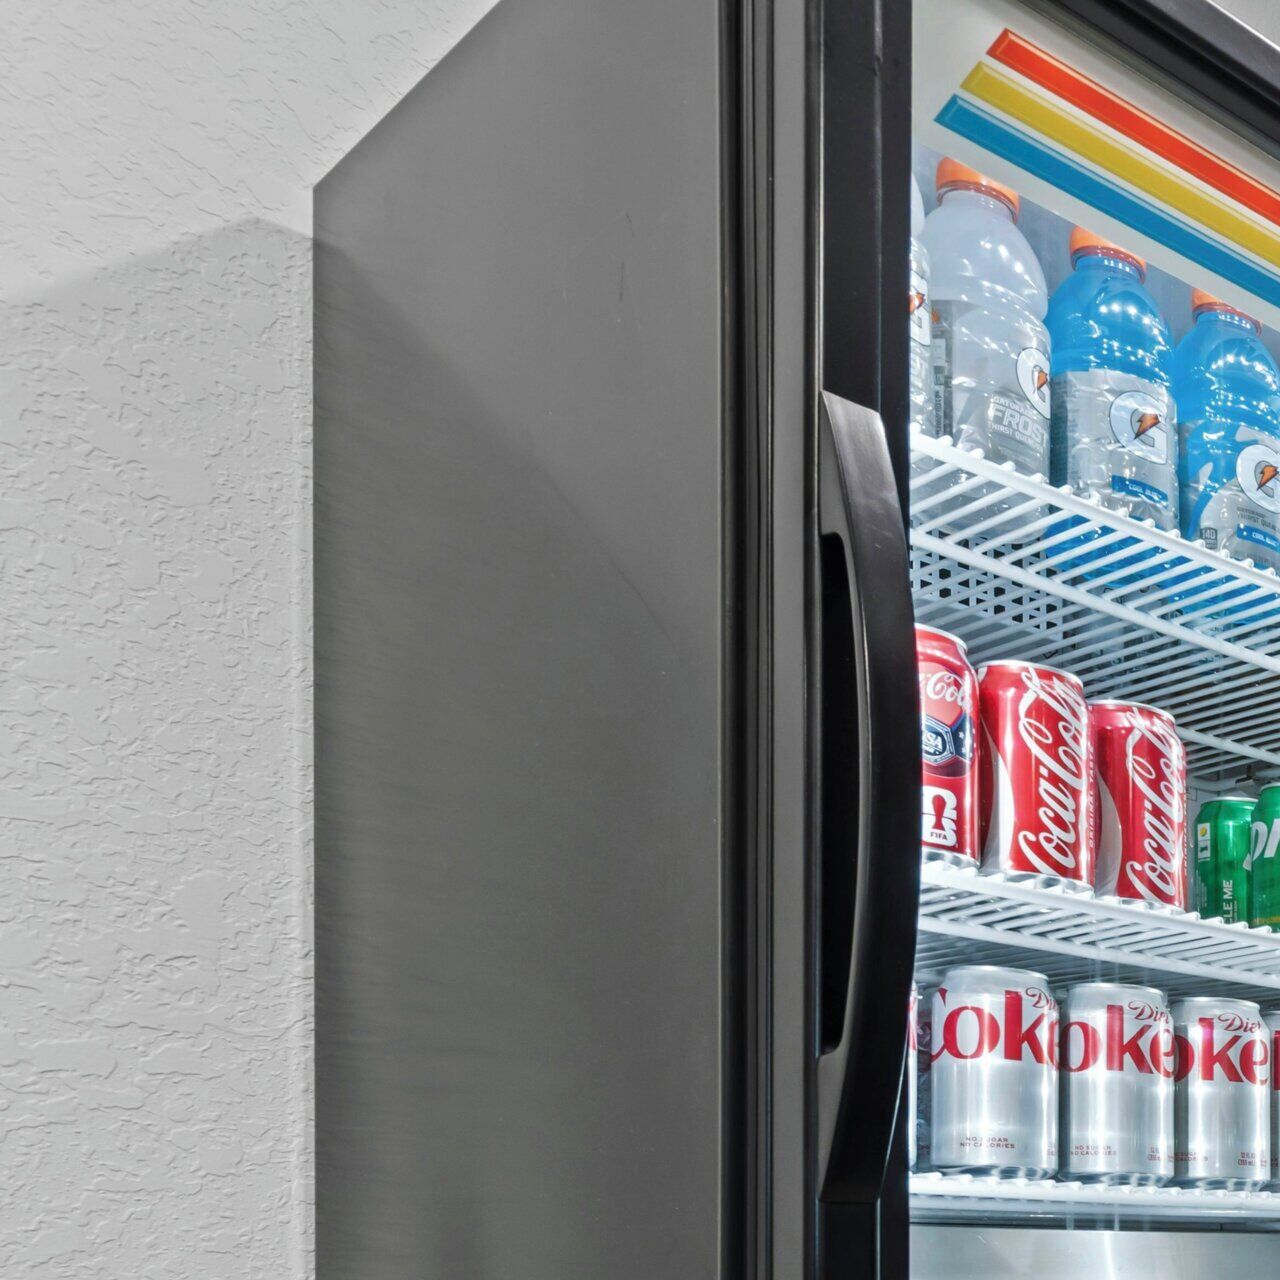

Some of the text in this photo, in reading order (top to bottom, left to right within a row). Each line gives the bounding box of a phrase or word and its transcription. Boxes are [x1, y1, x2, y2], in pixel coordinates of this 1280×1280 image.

[930, 832, 948, 841] FIFA
[1222, 879, 1233, 899] ME
[1059, 1004, 1175, 1079] oke
